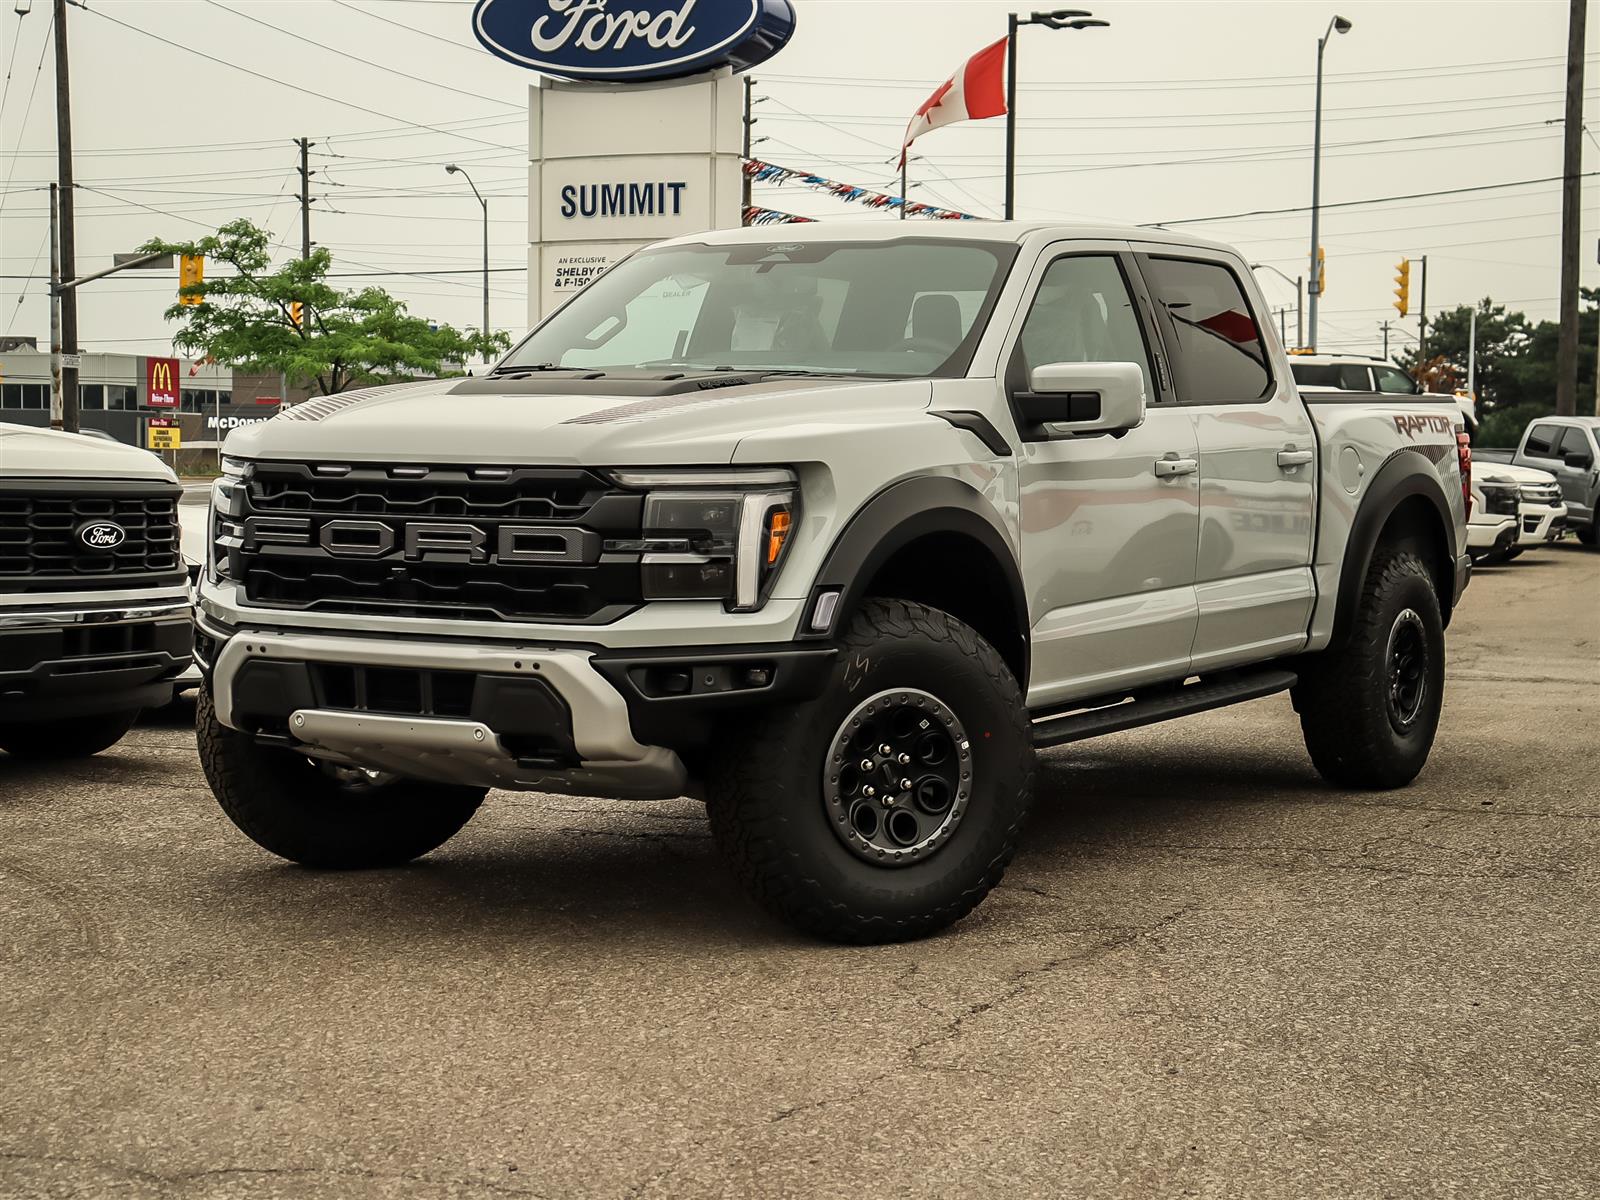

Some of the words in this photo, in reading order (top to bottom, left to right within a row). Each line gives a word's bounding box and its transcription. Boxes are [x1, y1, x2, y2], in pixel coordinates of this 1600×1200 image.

[531, 0, 696, 51] Ford
[561, 182, 686, 218] SUMMIT
[554, 278, 562, 287] &
[556, 267, 595, 276] SHELBY
[1393, 415, 1455, 442] RAPTOR
[90, 527, 117, 544] Ford
[244, 516, 598, 568] FORD
